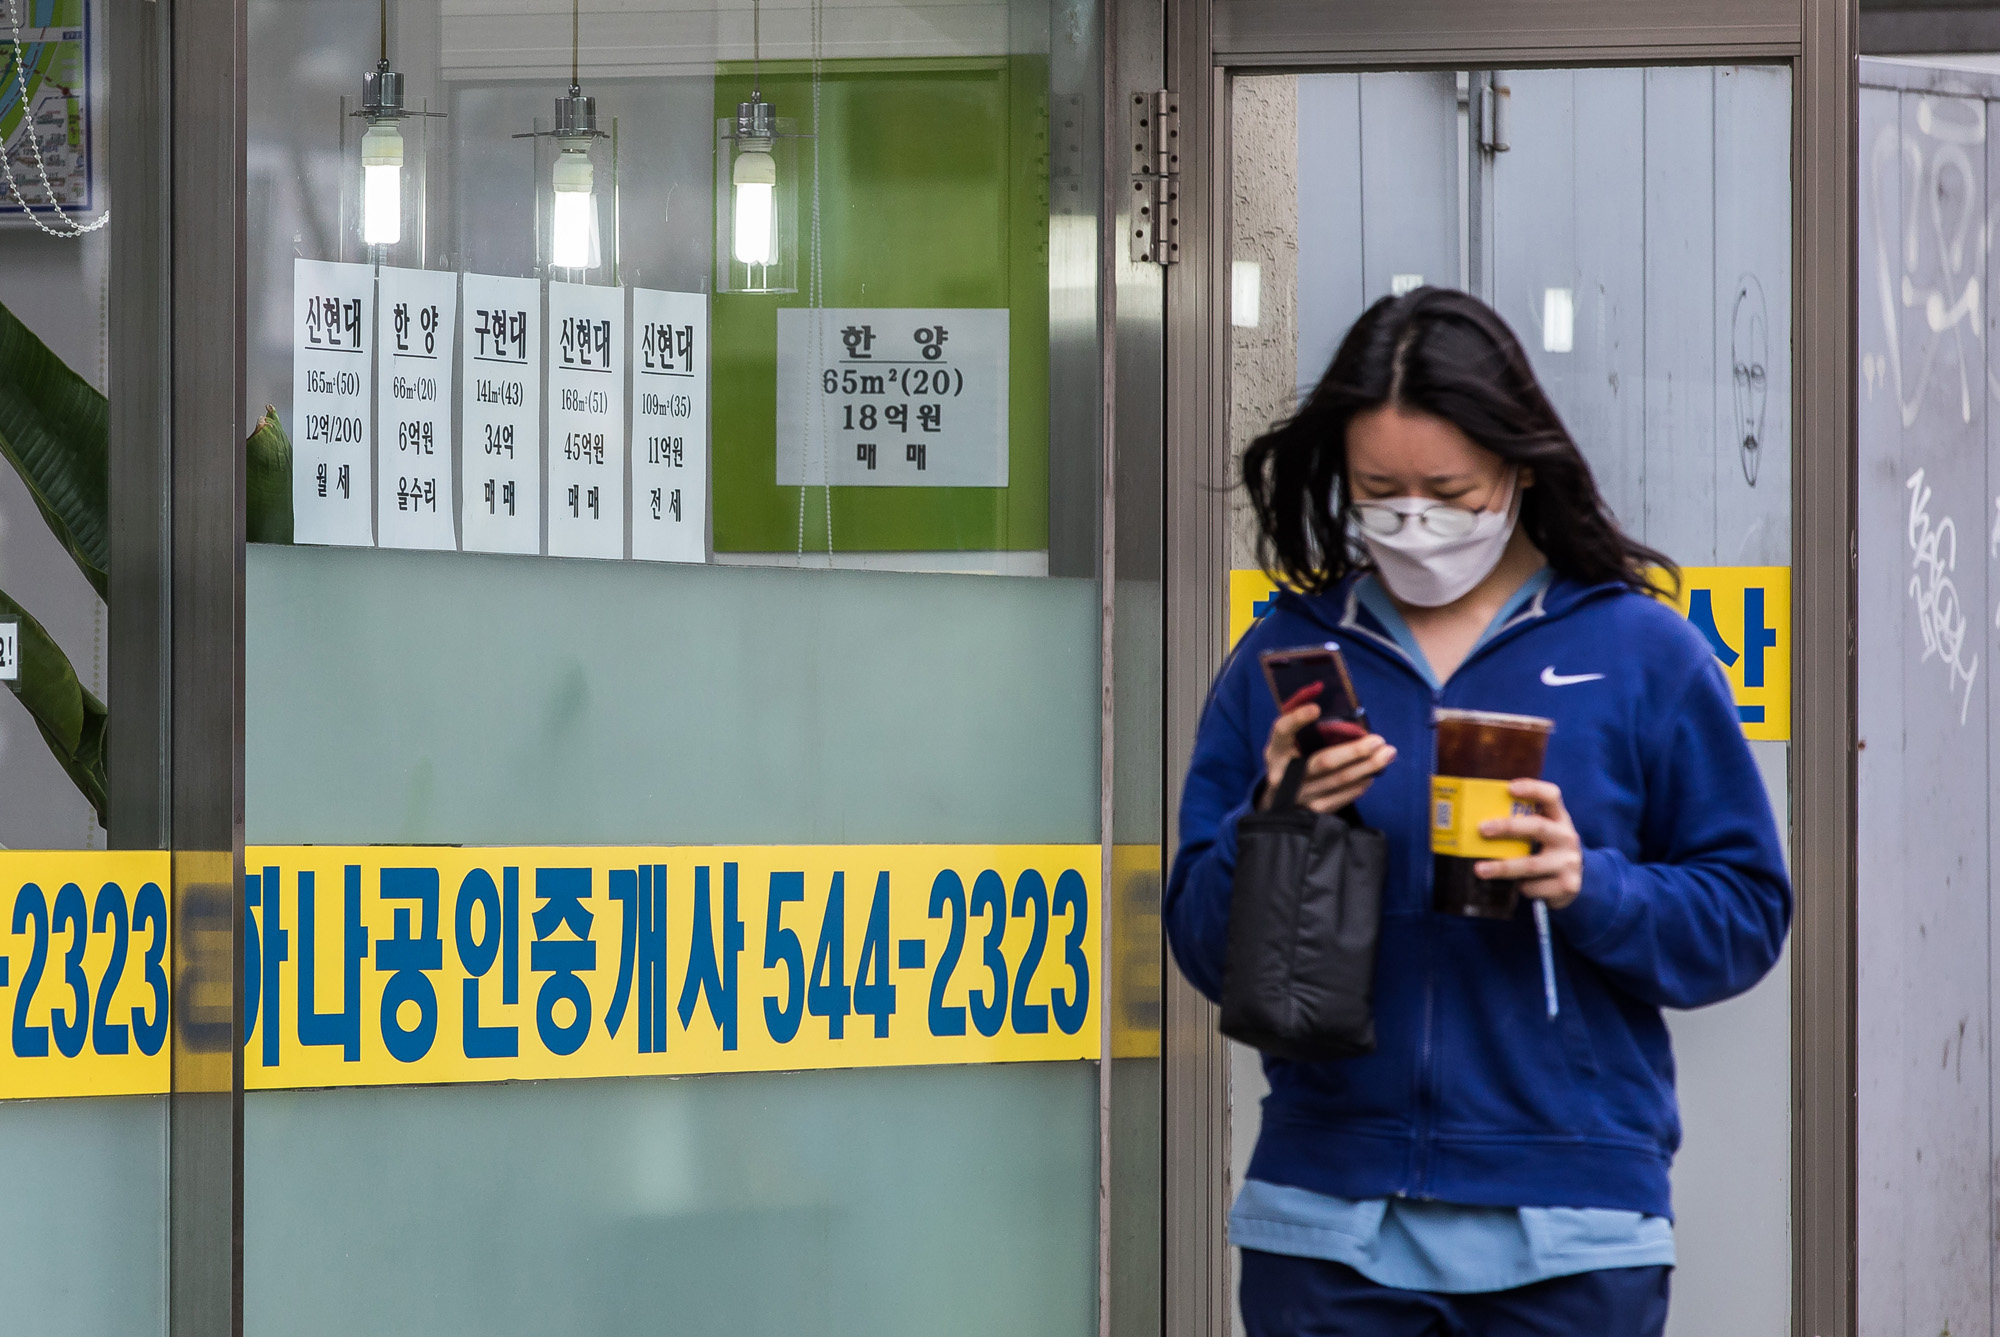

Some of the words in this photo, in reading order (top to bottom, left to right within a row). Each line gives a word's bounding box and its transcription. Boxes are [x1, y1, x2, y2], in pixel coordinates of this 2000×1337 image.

[306, 296, 362, 346] 신현대
[474, 310, 527, 359] 구현대
[559, 317, 611, 367] 신현대
[642, 323, 694, 371] 신현대
[307, 415, 362, 444] 12억/200
[844, 404, 940, 432] 18억원
[399, 421, 433, 455] 6억원
[485, 424, 513, 459] 34억
[565, 433, 603, 464] 45억원
[649, 436, 682, 467] 11억원
[397, 477, 435, 512] 올수리
[245, 863, 744, 1066] 하나공인중개사
[764, 870, 1088, 1043] 544-2323
